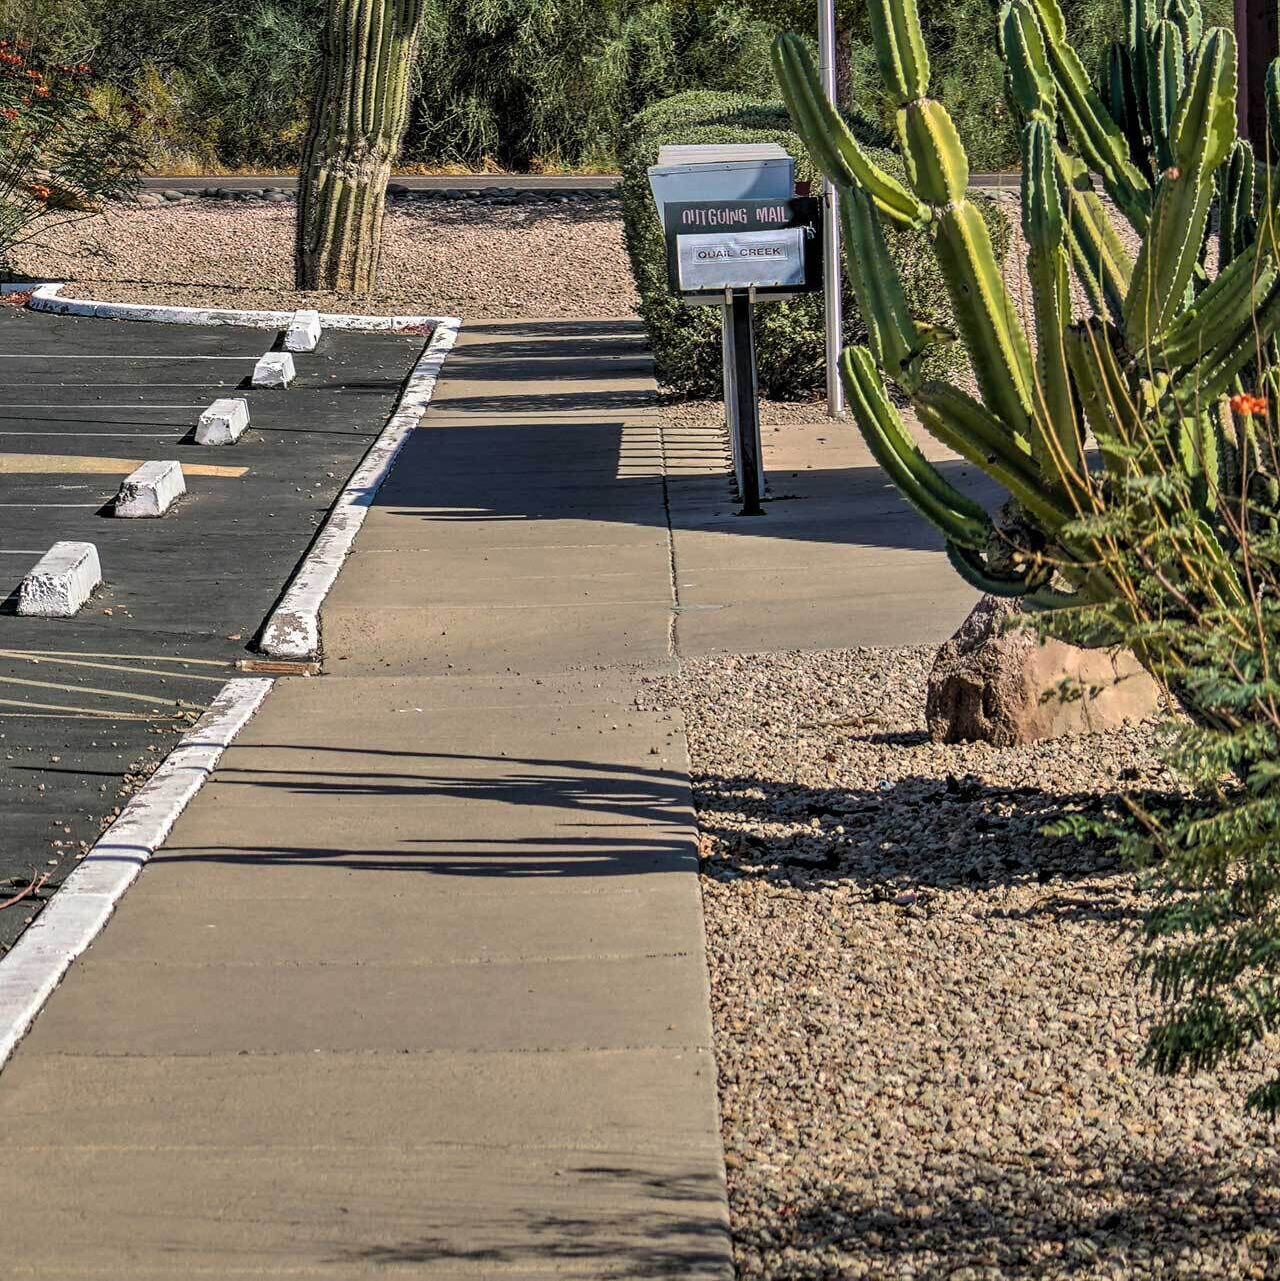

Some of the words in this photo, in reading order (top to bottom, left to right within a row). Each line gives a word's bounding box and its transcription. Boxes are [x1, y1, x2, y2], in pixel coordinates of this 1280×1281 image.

[682, 208, 748, 226] OUTGOING
[755, 206, 790, 223] MAIL
[697, 250, 734, 259] QUAIL
[739, 247, 782, 257] CREEK
